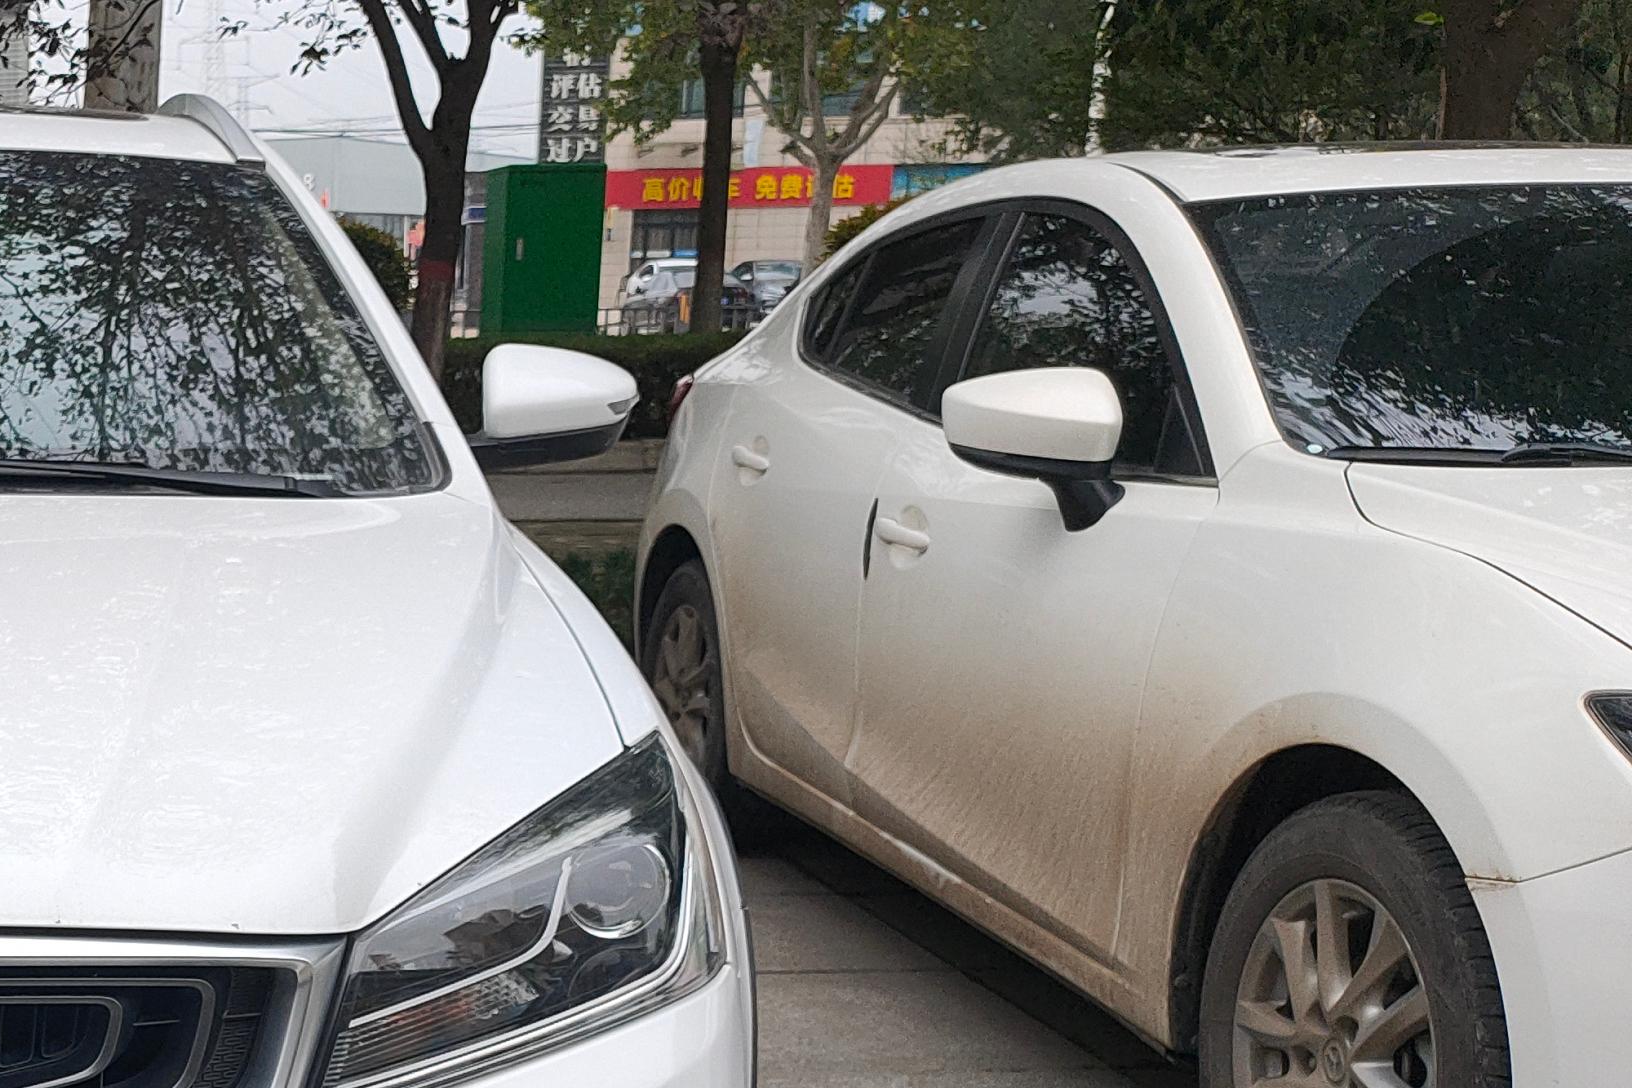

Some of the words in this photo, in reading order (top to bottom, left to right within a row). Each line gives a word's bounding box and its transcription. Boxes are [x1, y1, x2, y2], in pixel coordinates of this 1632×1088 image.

[550, 73, 602, 99] 评估
[545, 137, 598, 163] 过户
[755, 174, 855, 200] 免费估
